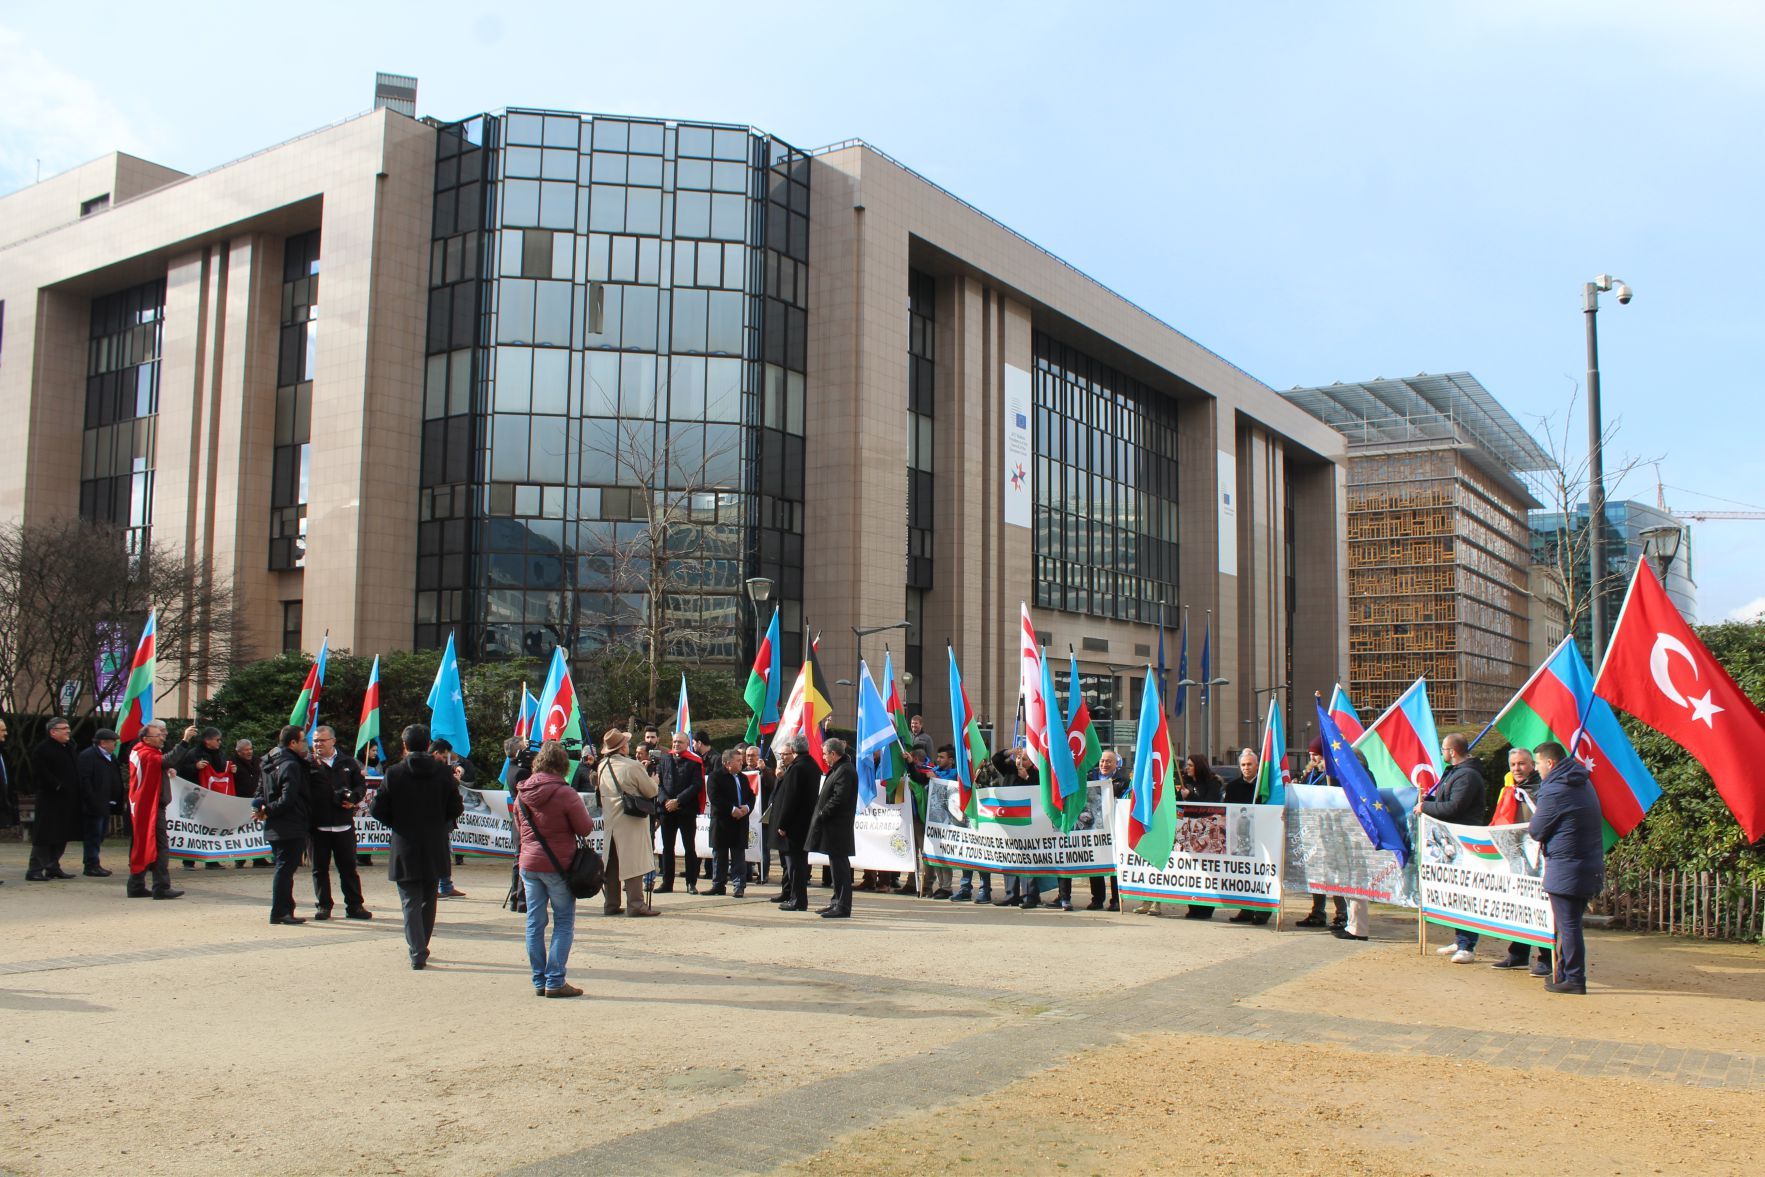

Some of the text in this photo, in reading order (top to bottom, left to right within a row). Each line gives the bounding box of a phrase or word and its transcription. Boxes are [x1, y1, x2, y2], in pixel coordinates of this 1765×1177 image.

[166, 820, 218, 836] GENOCIDE
[926, 826, 1112, 851] CONNAITRE LE GENOCIDE DE KHODJALY EST CELUI DE DIRE
[187, 837, 222, 851] MORTS
[225, 839, 242, 850] EN
[940, 843, 957, 855] "NON"
[966, 847, 982, 859] TOUS
[984, 849, 994, 861] LES
[994, 851, 1032, 864] GENOCIDES
[1033, 852, 1053, 864] DANS
[1055, 852, 1064, 864] LE
[1066, 850, 1095, 863] MONDE
[1177, 857, 1199, 870] ONT
[1201, 859, 1220, 872] ETE
[1224, 861, 1251, 874] TUES
[1254, 863, 1277, 876] LORS
[1131, 872, 1145, 884] LA
[1149, 873, 1202, 888] GENOCIDE
[1205, 877, 1218, 890] DE
[1221, 878, 1271, 894] KHODJALY
[1420, 864, 1458, 885] GENOCIDE
[1460, 869, 1471, 888] DE
[1472, 872, 1511, 893] KHODJALY
[1426, 887, 1440, 904] PAR
[1441, 890, 1477, 914] L'ARMENIE
[1479, 899, 1489, 916] LE
[1490, 901, 1500, 918] 26
